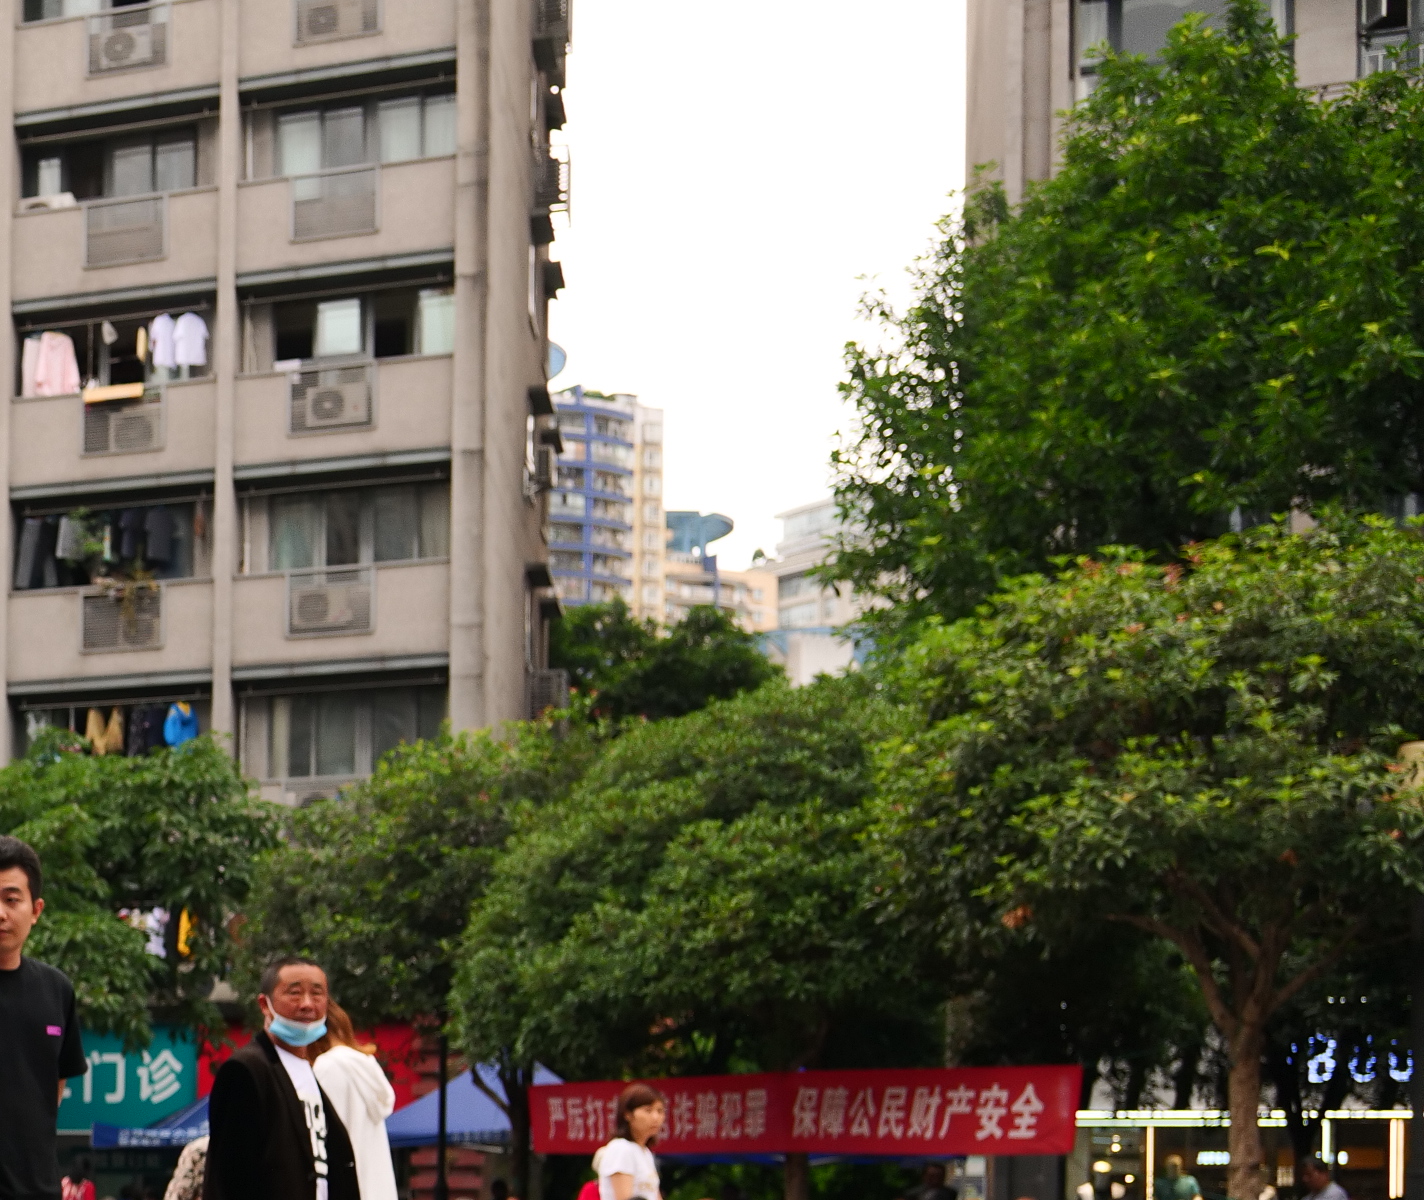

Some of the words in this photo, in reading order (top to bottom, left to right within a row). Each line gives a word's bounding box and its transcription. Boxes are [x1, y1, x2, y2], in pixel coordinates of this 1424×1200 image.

[63, 1049, 183, 1104] 门诊
[792, 1082, 1045, 1141] 保障公民财产安全
